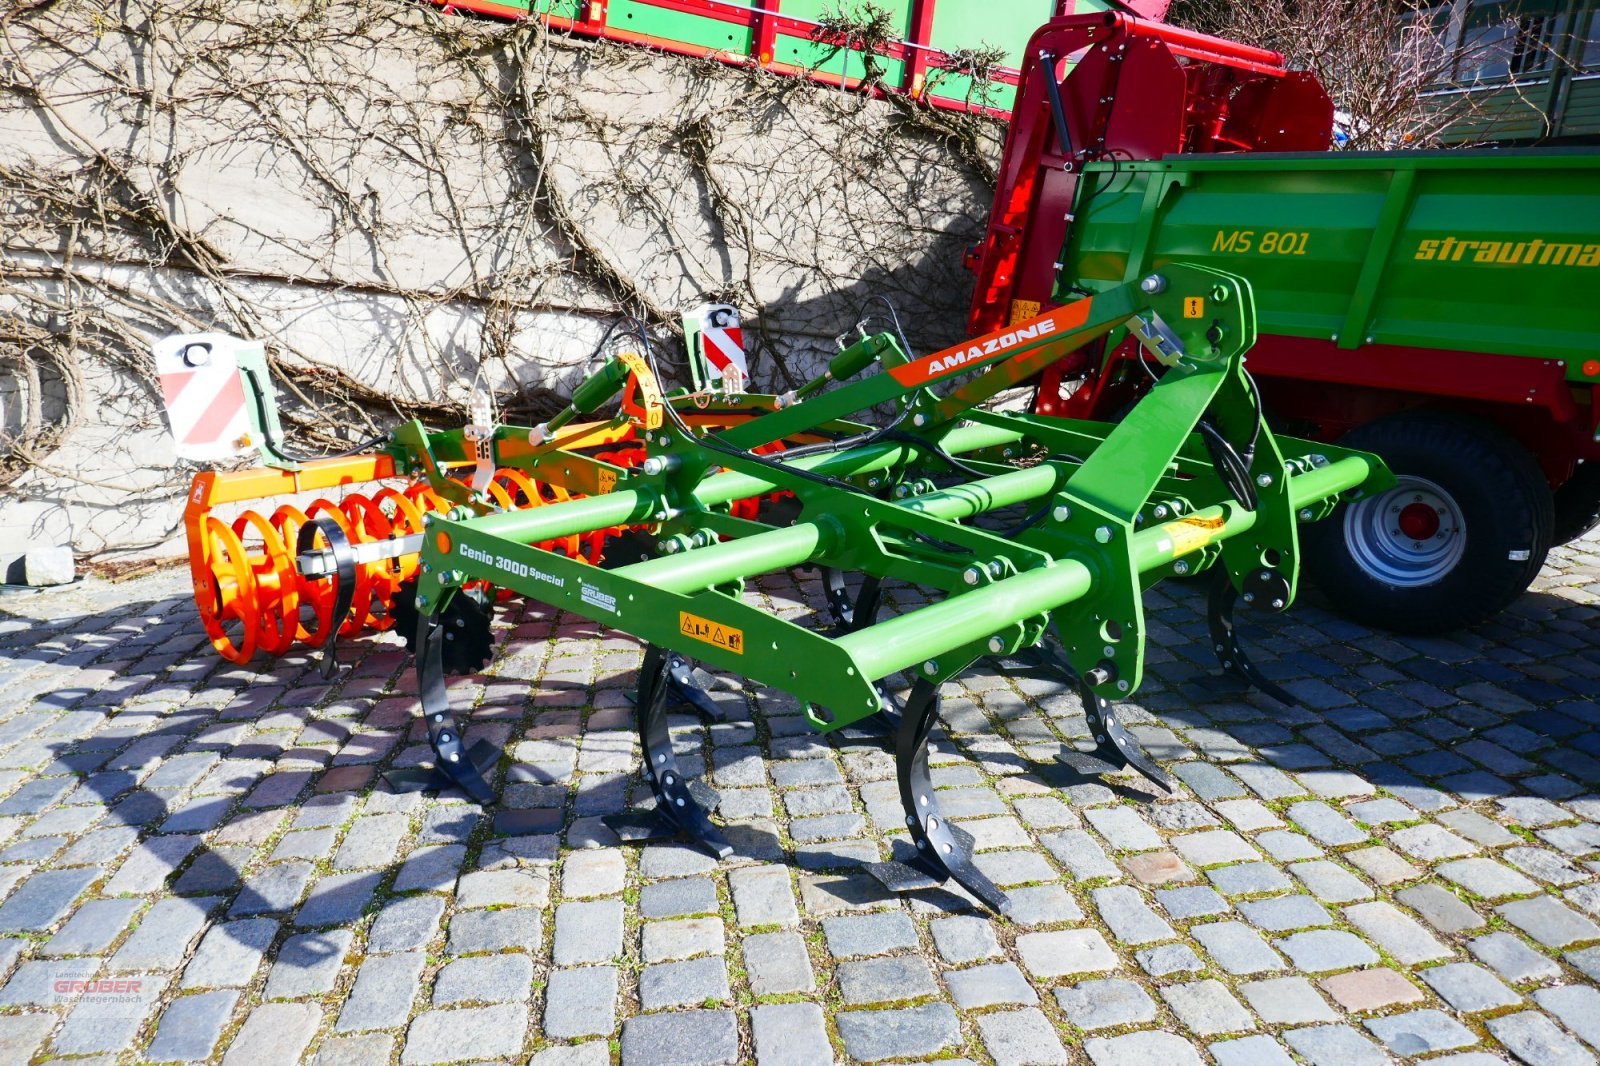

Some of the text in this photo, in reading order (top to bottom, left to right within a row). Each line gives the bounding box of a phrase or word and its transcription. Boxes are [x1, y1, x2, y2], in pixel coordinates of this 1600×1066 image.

[1212, 230, 1310, 255] MS 801
[1414, 236, 1600, 267] strautma
[928, 318, 1056, 375] AMAZONE
[649, 393, 658, 408] 2
[651, 412, 658, 426] 0
[460, 543, 493, 565] Cenio
[495, 556, 528, 578] 3000
[529, 567, 564, 587] Special
[581, 586, 616, 606] GRUBER
